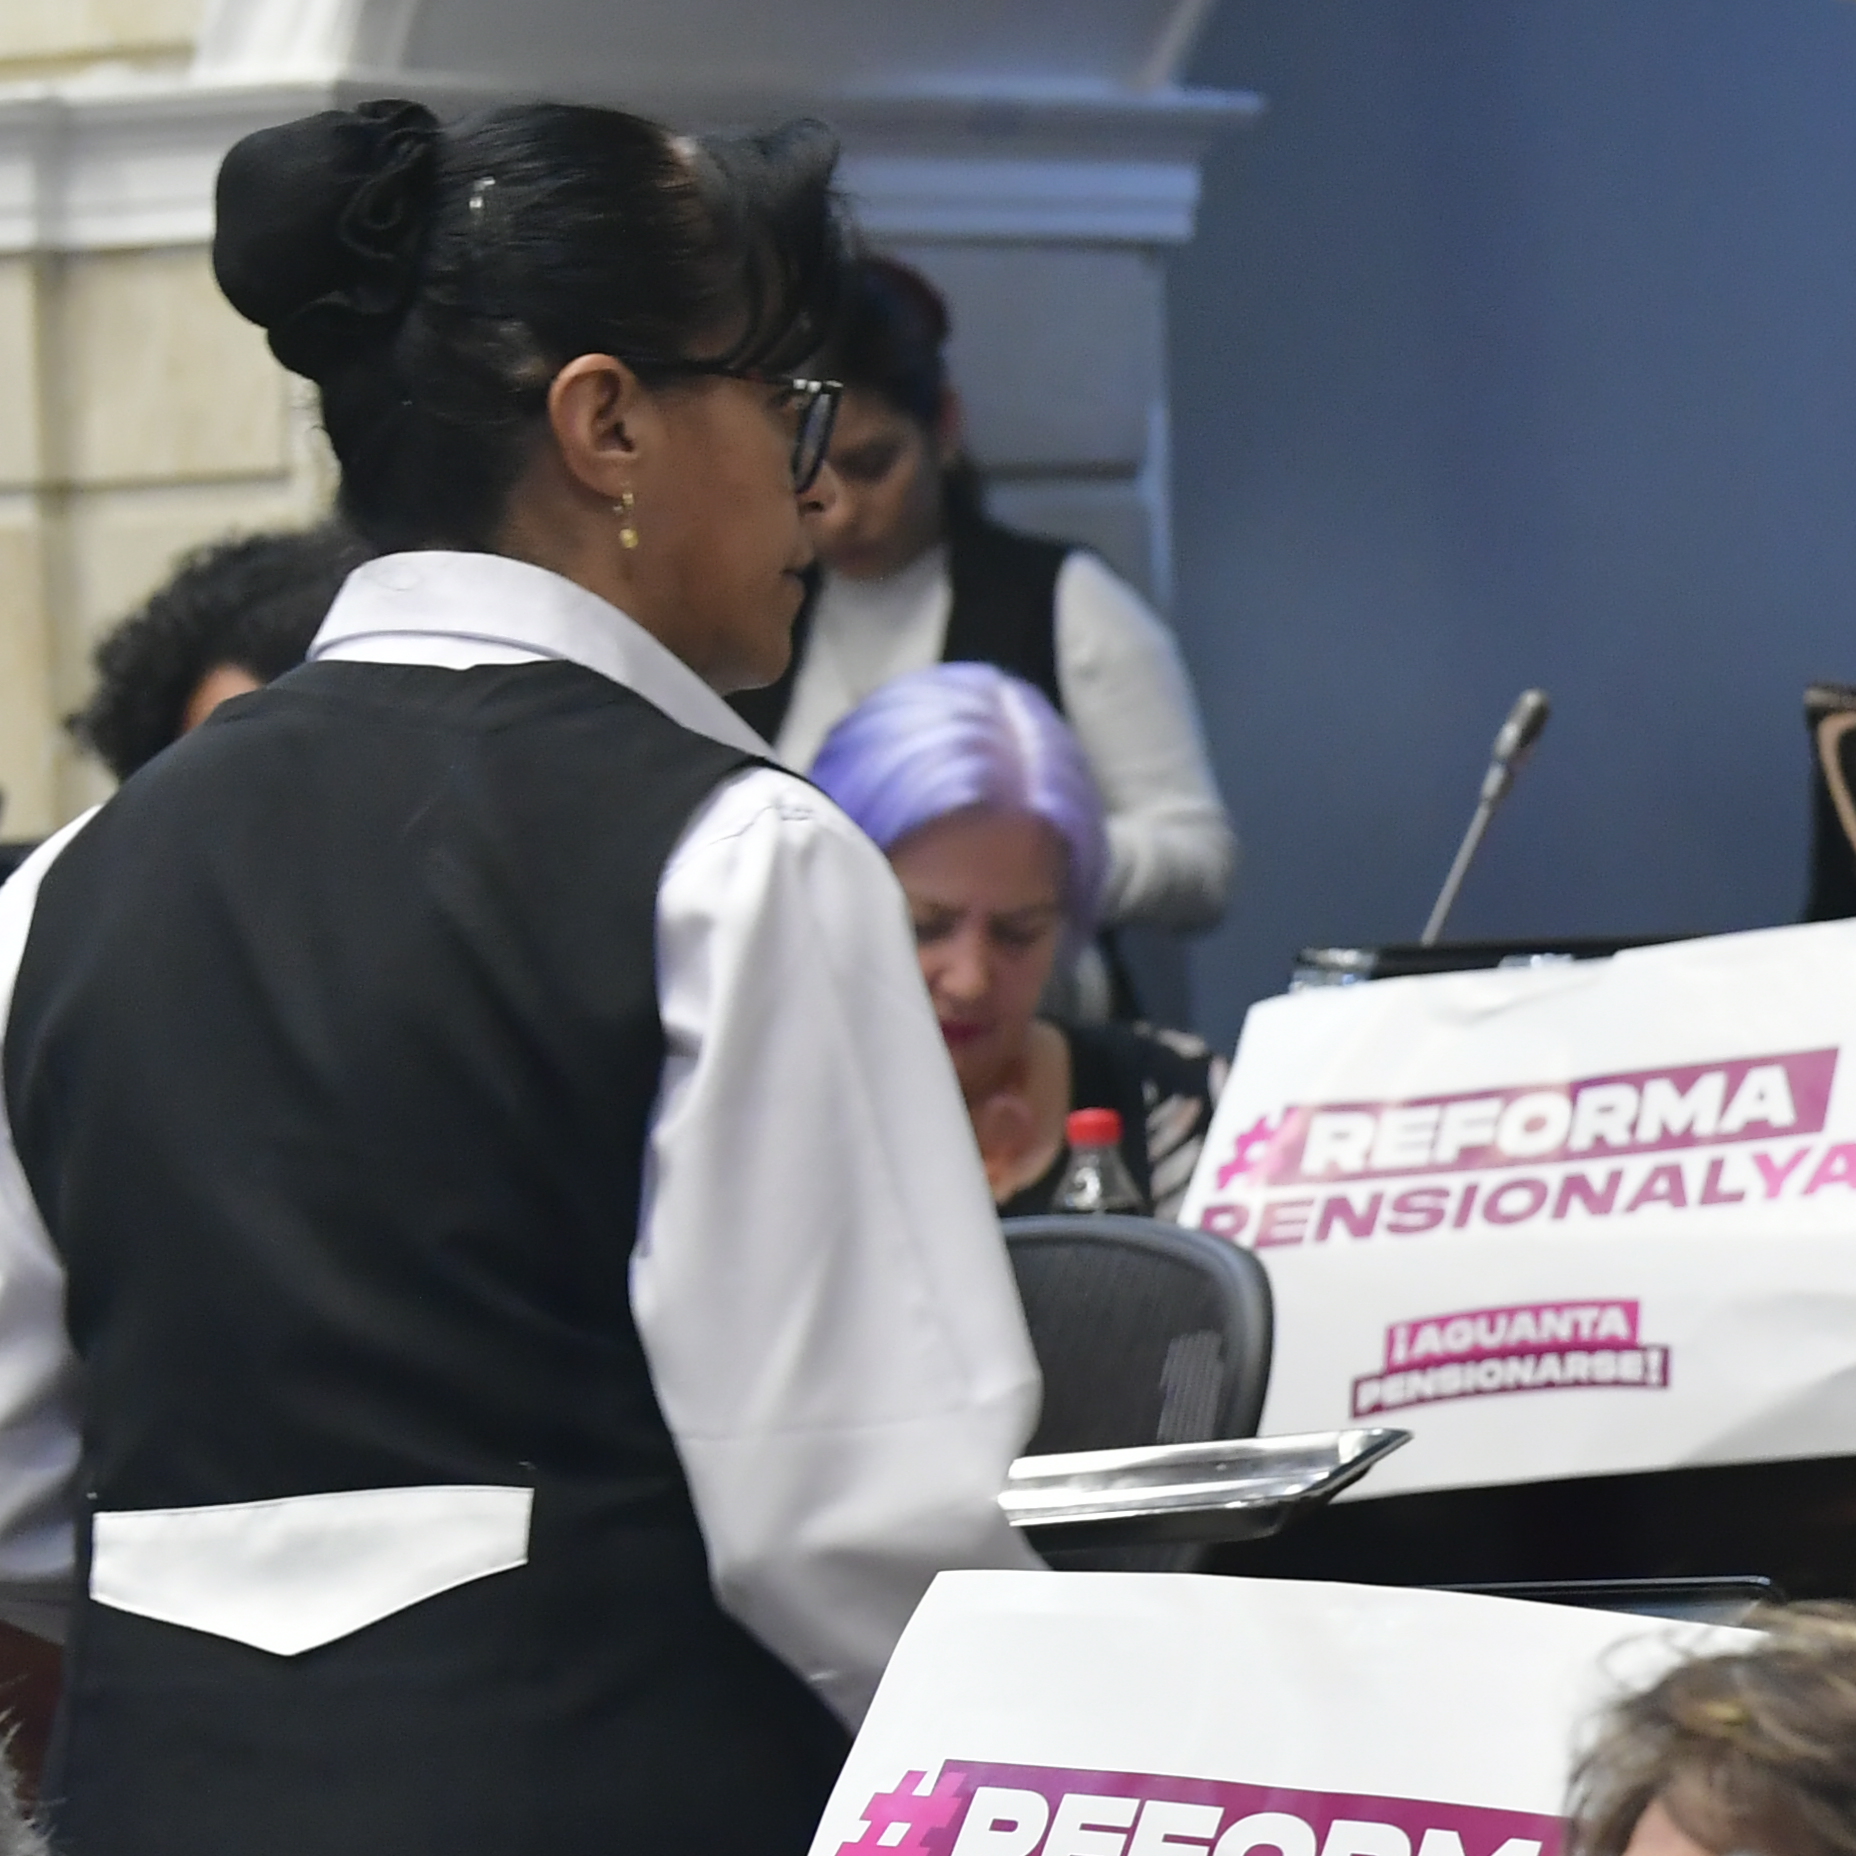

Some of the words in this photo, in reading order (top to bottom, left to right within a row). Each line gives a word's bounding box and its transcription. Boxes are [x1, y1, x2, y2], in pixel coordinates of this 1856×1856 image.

[1215, 1066, 1797, 1189] #REFORMA
[1390, 1305, 1631, 1365] ¡AGUANTA
[1355, 1349, 1662, 1413] PENSIONARSE!
